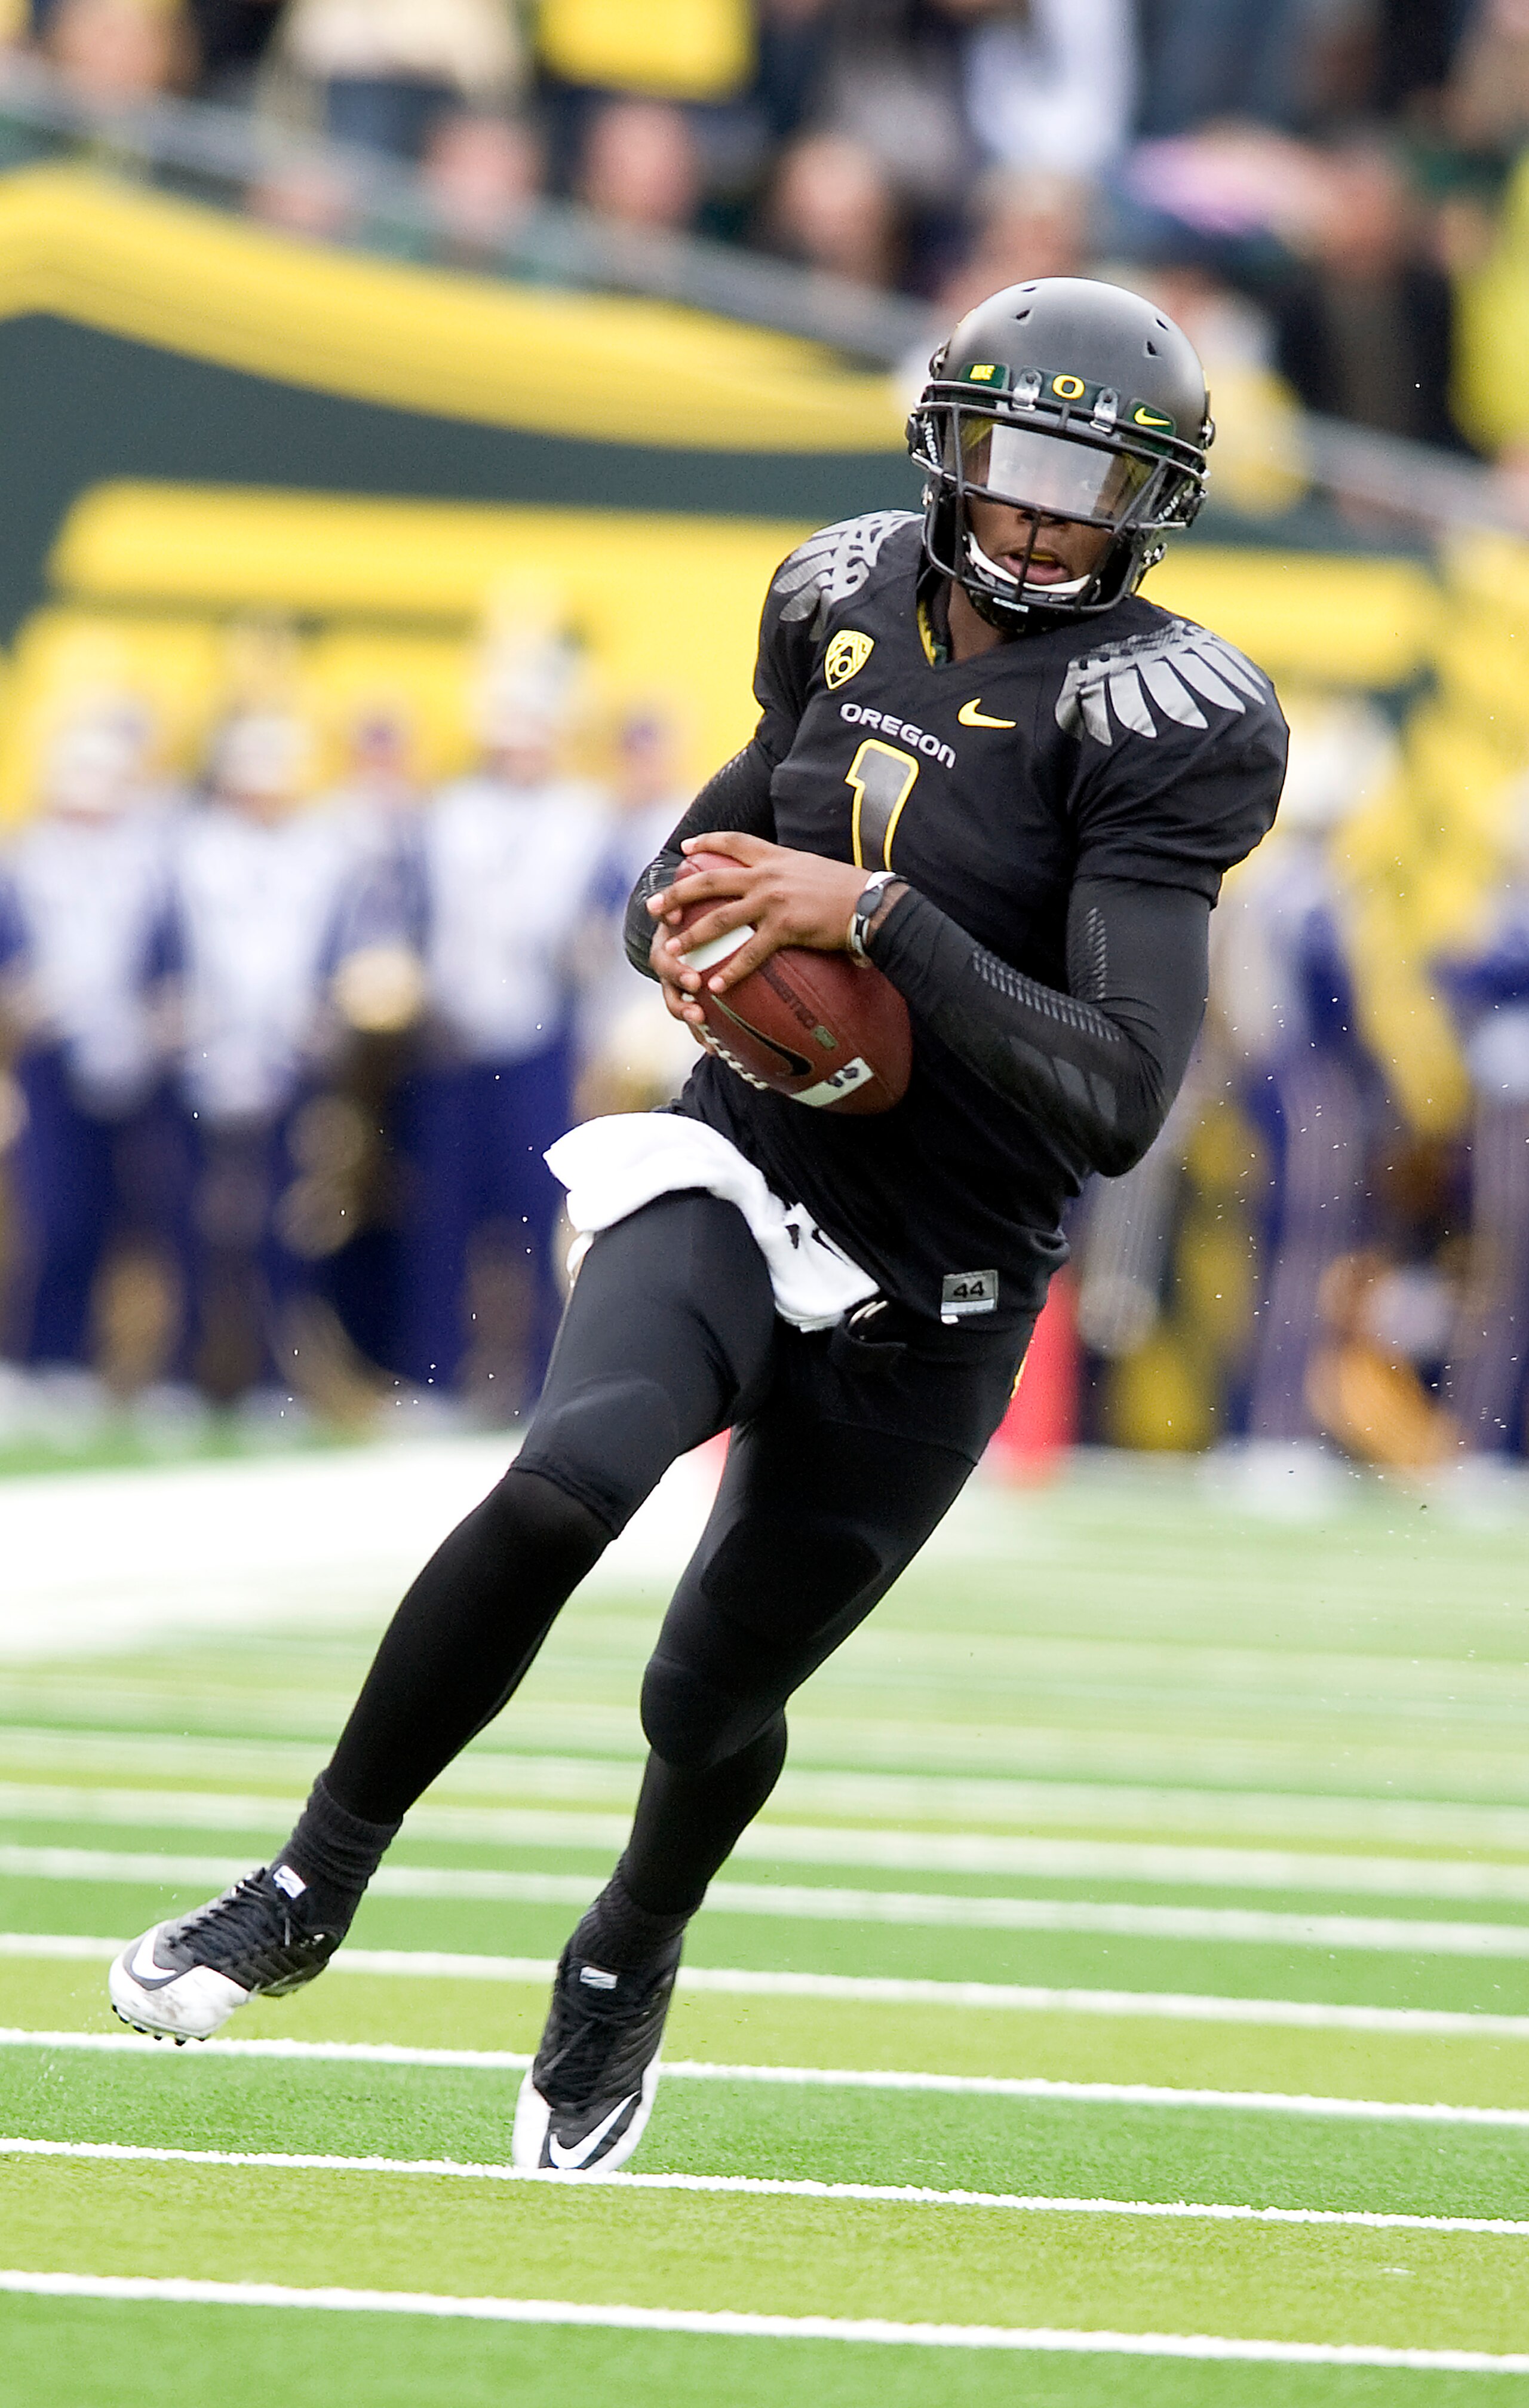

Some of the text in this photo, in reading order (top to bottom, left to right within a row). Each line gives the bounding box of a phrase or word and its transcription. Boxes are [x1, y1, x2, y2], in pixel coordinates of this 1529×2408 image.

[1052, 374, 1085, 400] O
[840, 703, 956, 769] OREGON
[845, 738, 919, 872] 1
[954, 1280, 984, 1298] 44
